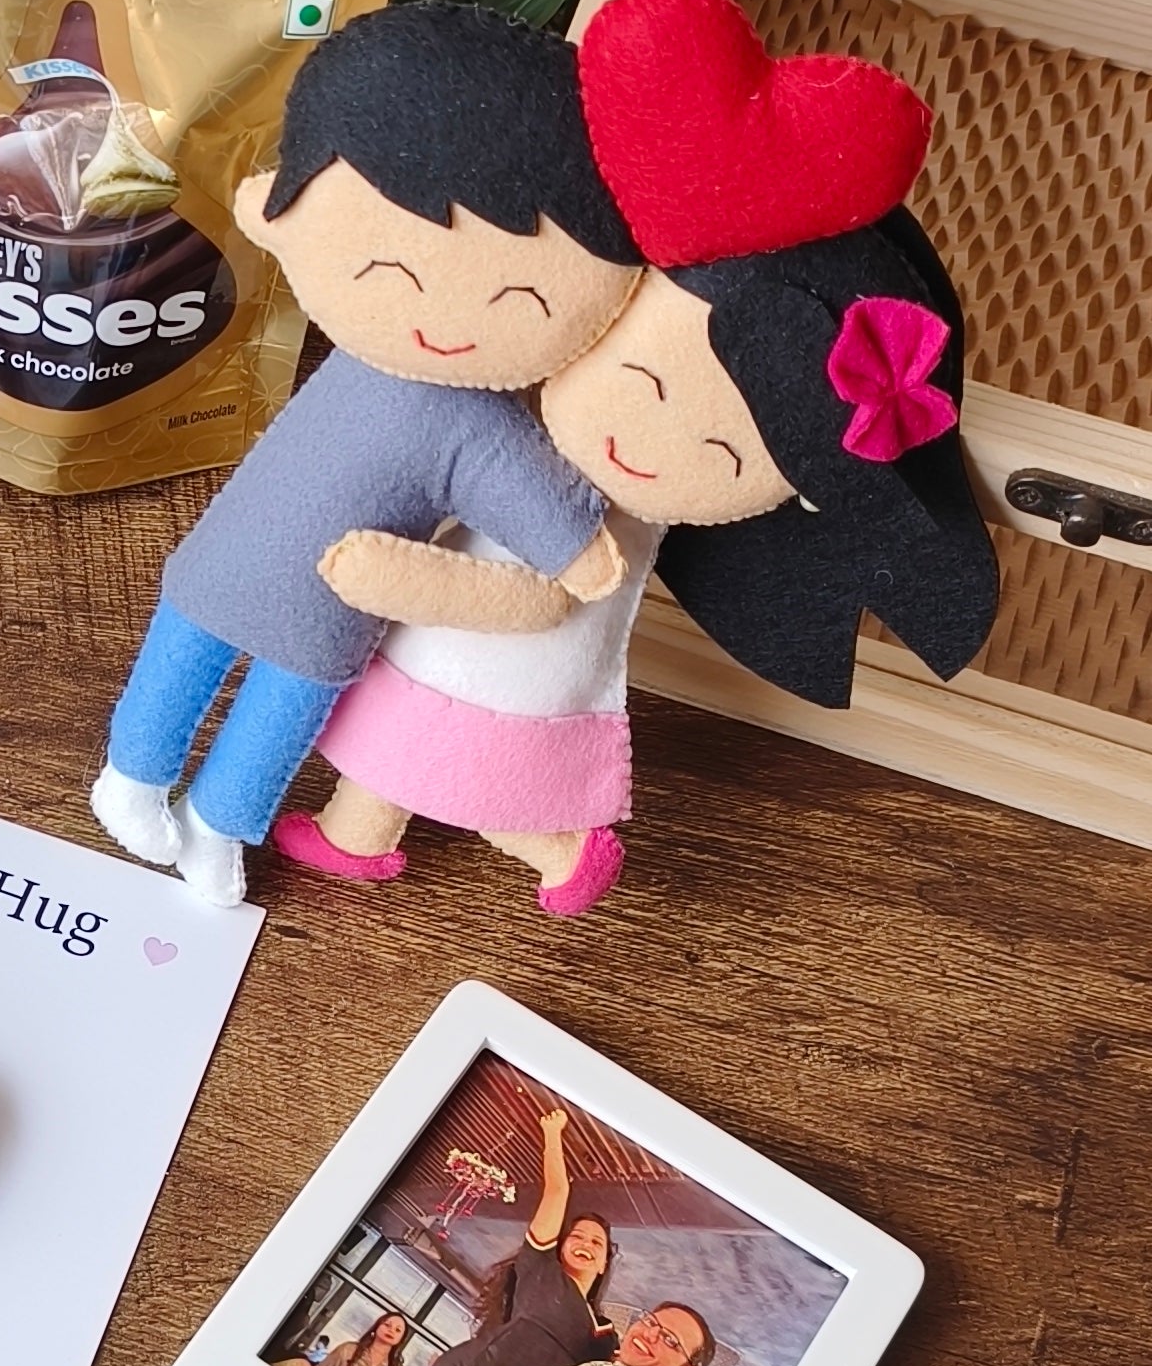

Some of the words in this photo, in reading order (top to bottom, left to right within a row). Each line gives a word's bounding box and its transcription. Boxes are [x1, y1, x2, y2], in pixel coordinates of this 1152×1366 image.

[10, 350, 134, 382] chocolate
[168, 416, 188, 431] Milk
[190, 403, 237, 424] Chocolate
